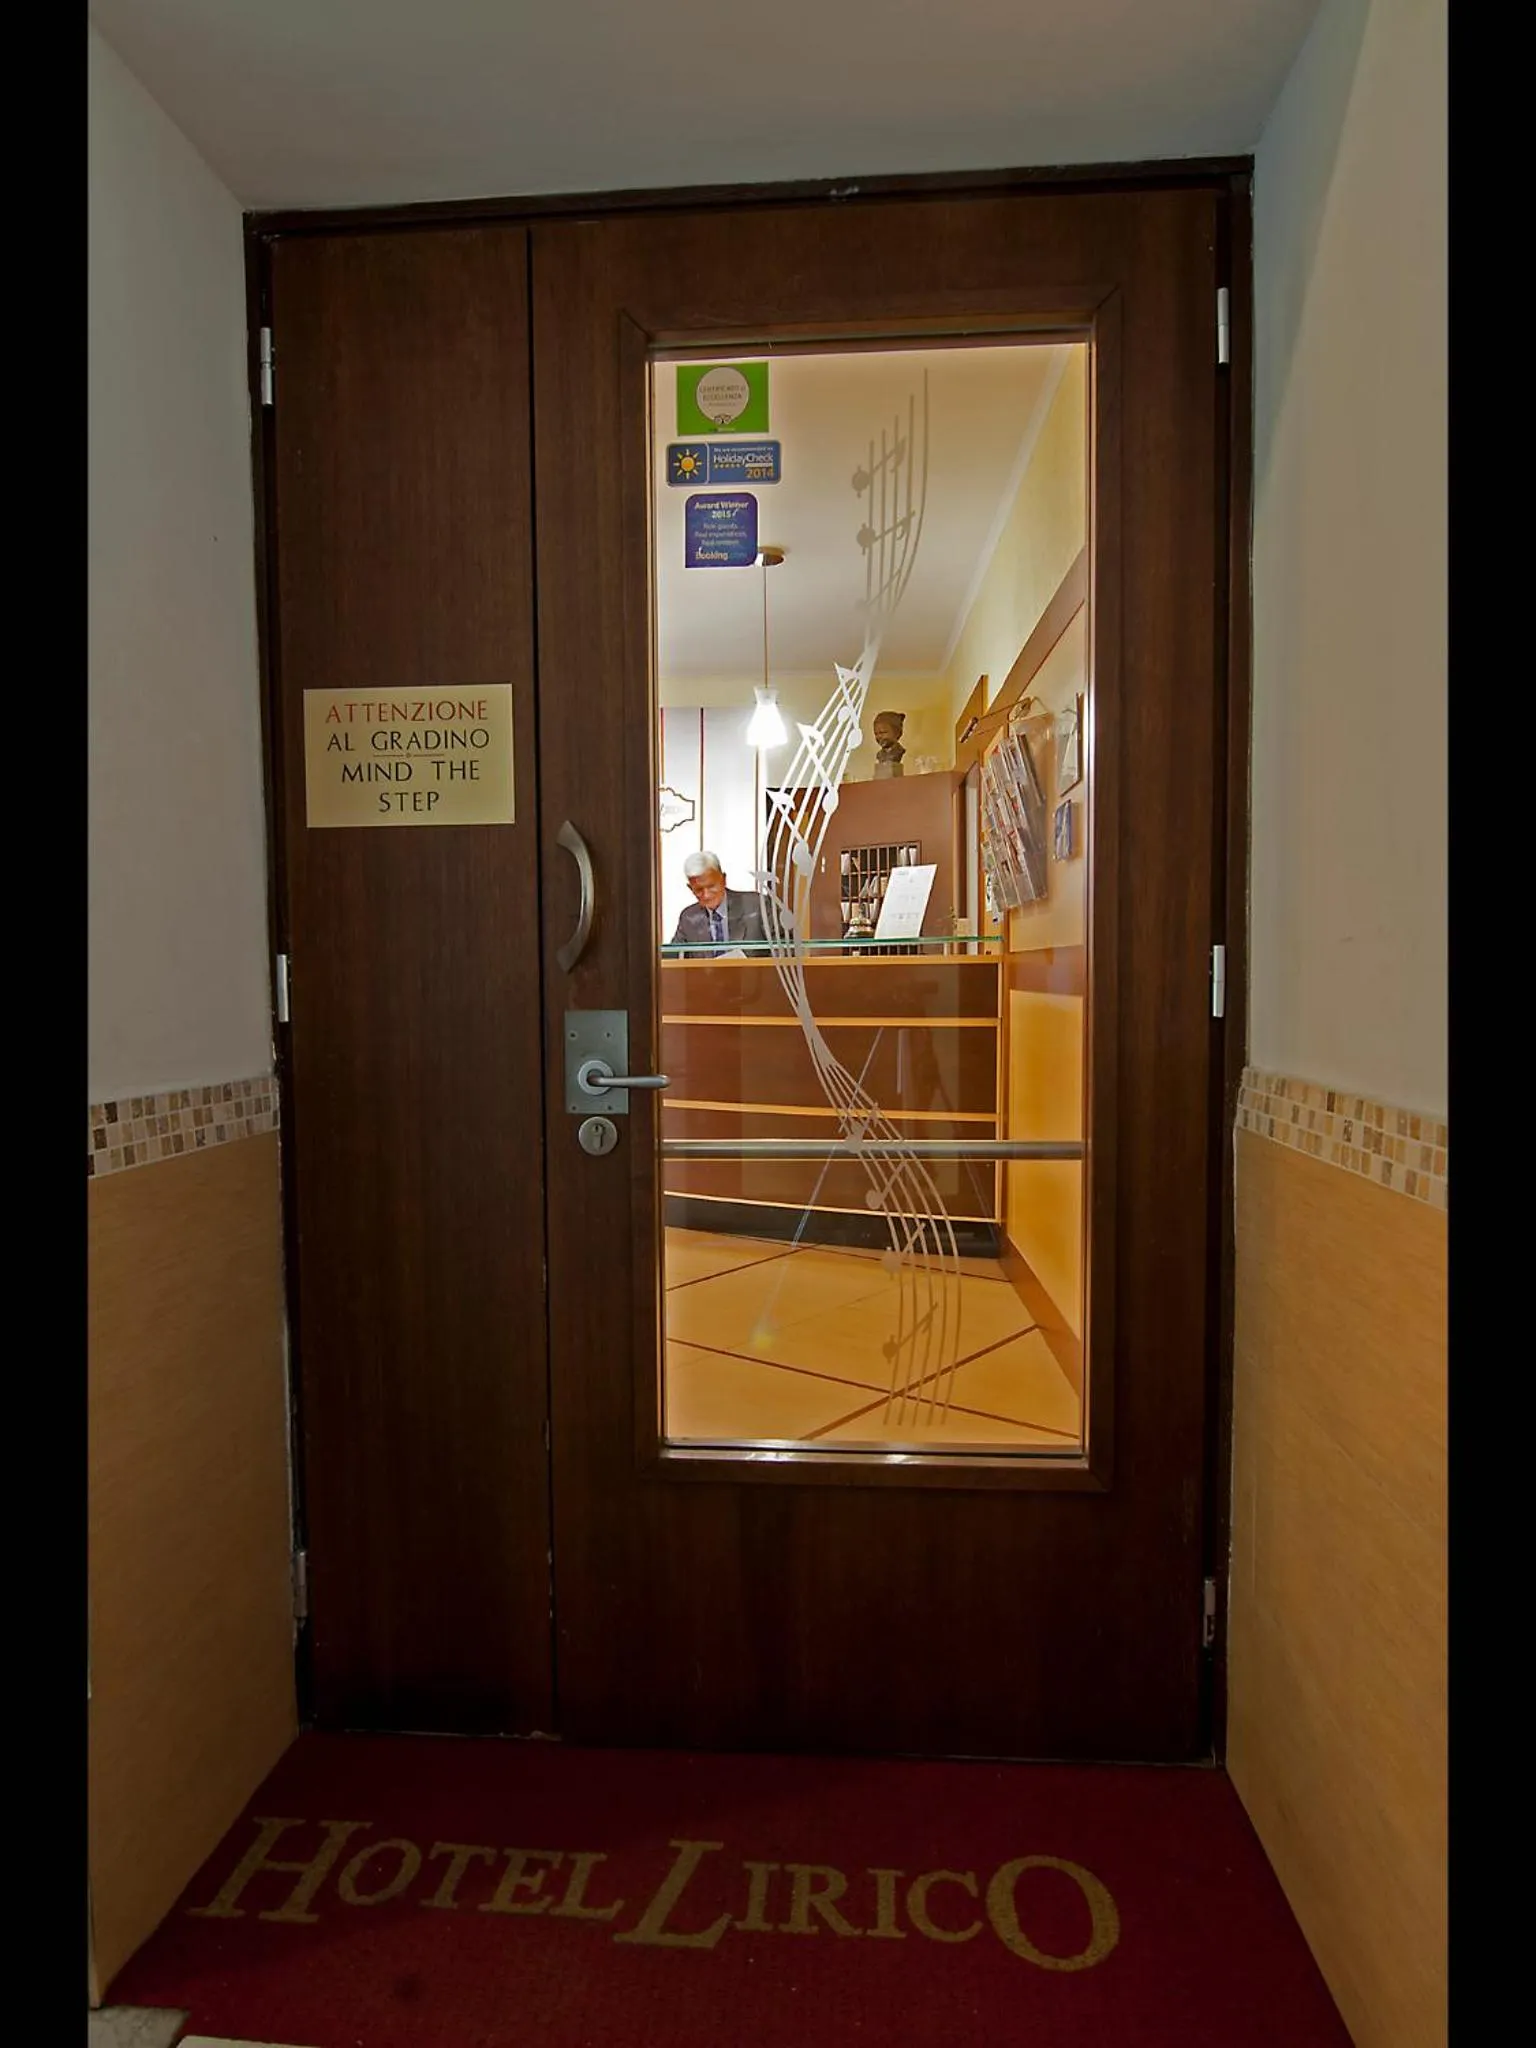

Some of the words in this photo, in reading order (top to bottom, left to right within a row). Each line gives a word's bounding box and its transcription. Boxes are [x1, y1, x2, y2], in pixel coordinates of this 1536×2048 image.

[713, 453, 774, 466] HolidayCheck
[744, 467, 774, 479] 2014
[694, 502, 719, 510] Award
[720, 501, 749, 510] Winner
[325, 700, 488, 724] ATTENZIONE
[327, 733, 355, 752] AL
[371, 728, 490, 751] GRADINO
[341, 761, 413, 783] MIND
[430, 760, 480, 781] THE
[378, 791, 440, 813] STEP
[185, 1816, 626, 1924] HOTEL
[613, 1839, 1121, 1973] LIRICO
